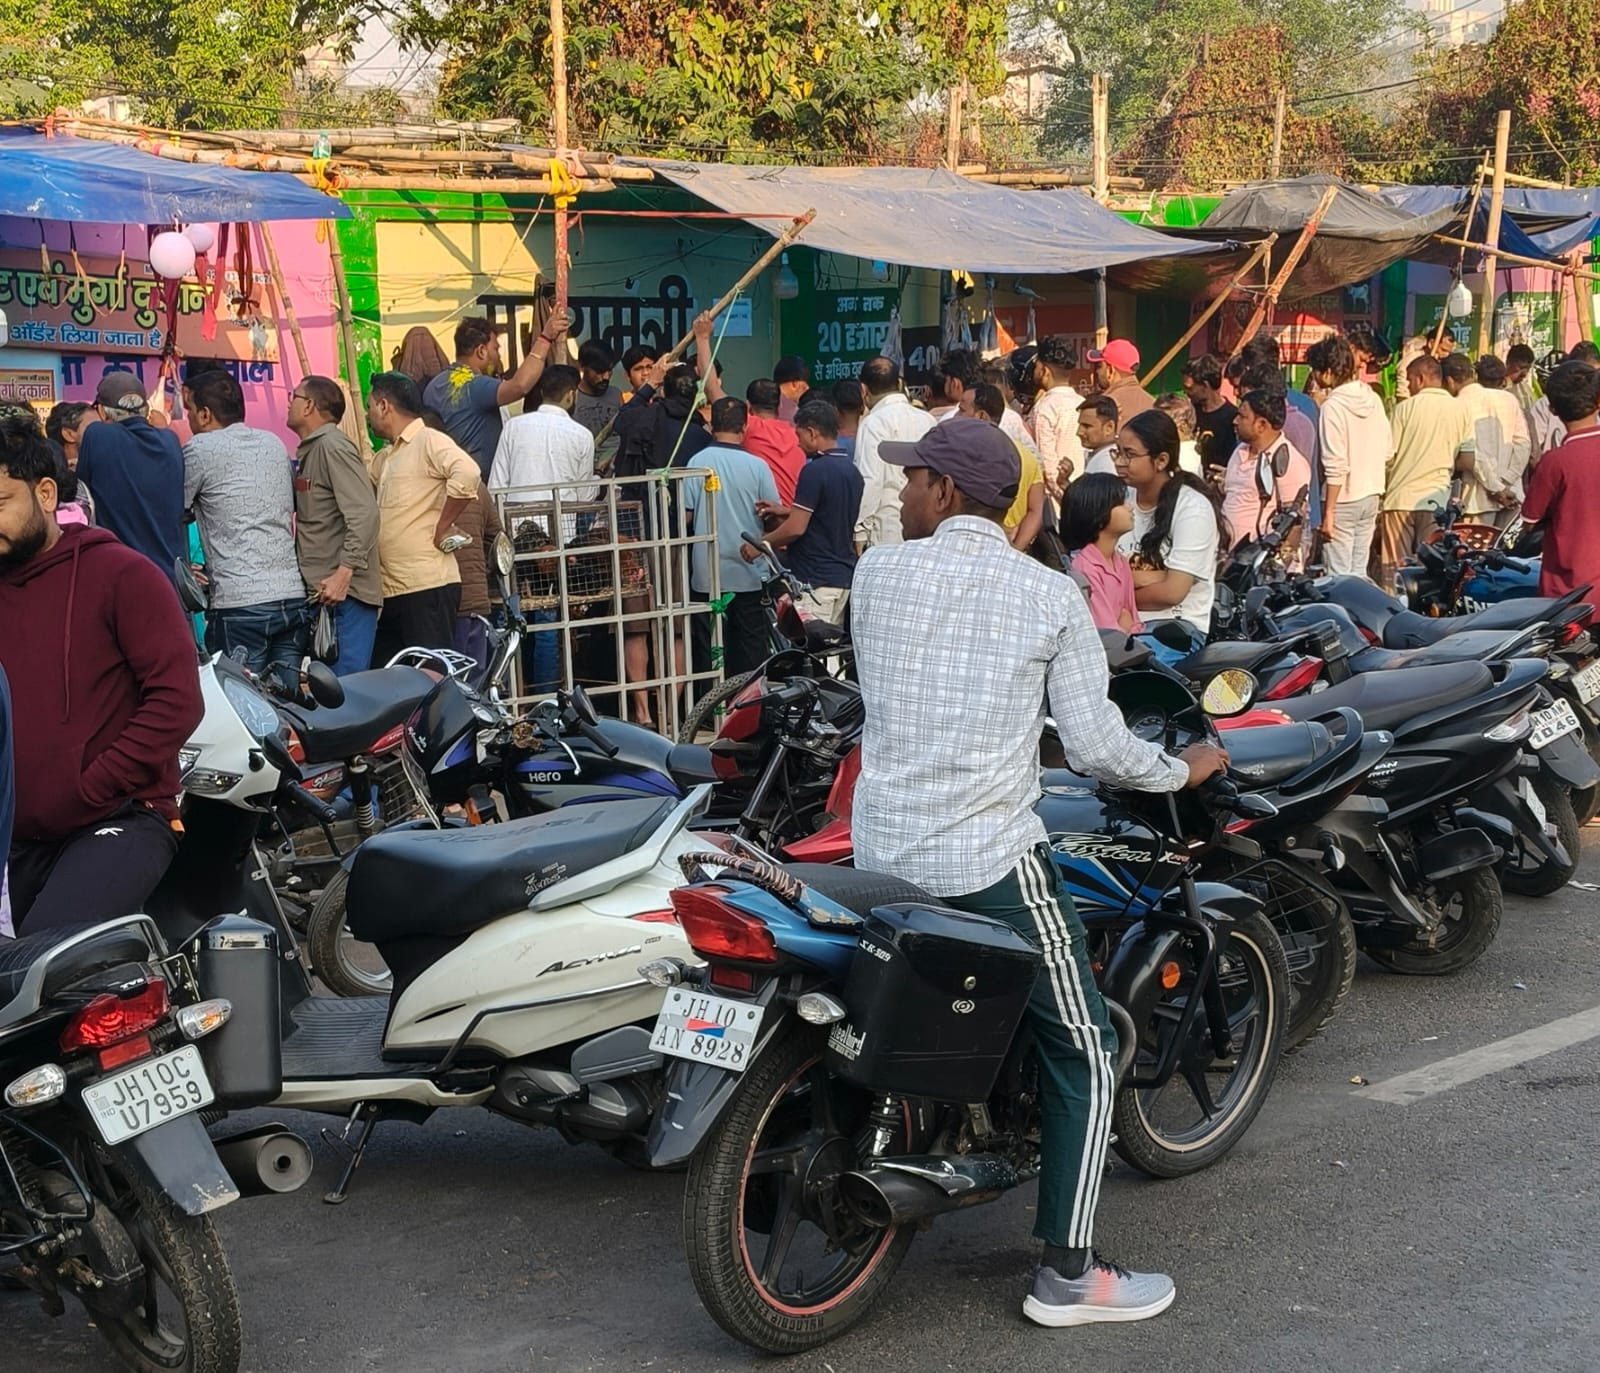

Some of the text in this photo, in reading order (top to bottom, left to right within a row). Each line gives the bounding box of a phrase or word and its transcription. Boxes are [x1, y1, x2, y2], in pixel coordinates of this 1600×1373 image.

[66, 263, 126, 326] मुर्गा
[131, 280, 214, 329] दुान
[10, 321, 162, 349] ऑर्डर लिया जाता है
[818, 321, 841, 353] 20
[656, 1024, 745, 1064] AN 8928
[119, 1080, 202, 1130] U7959
